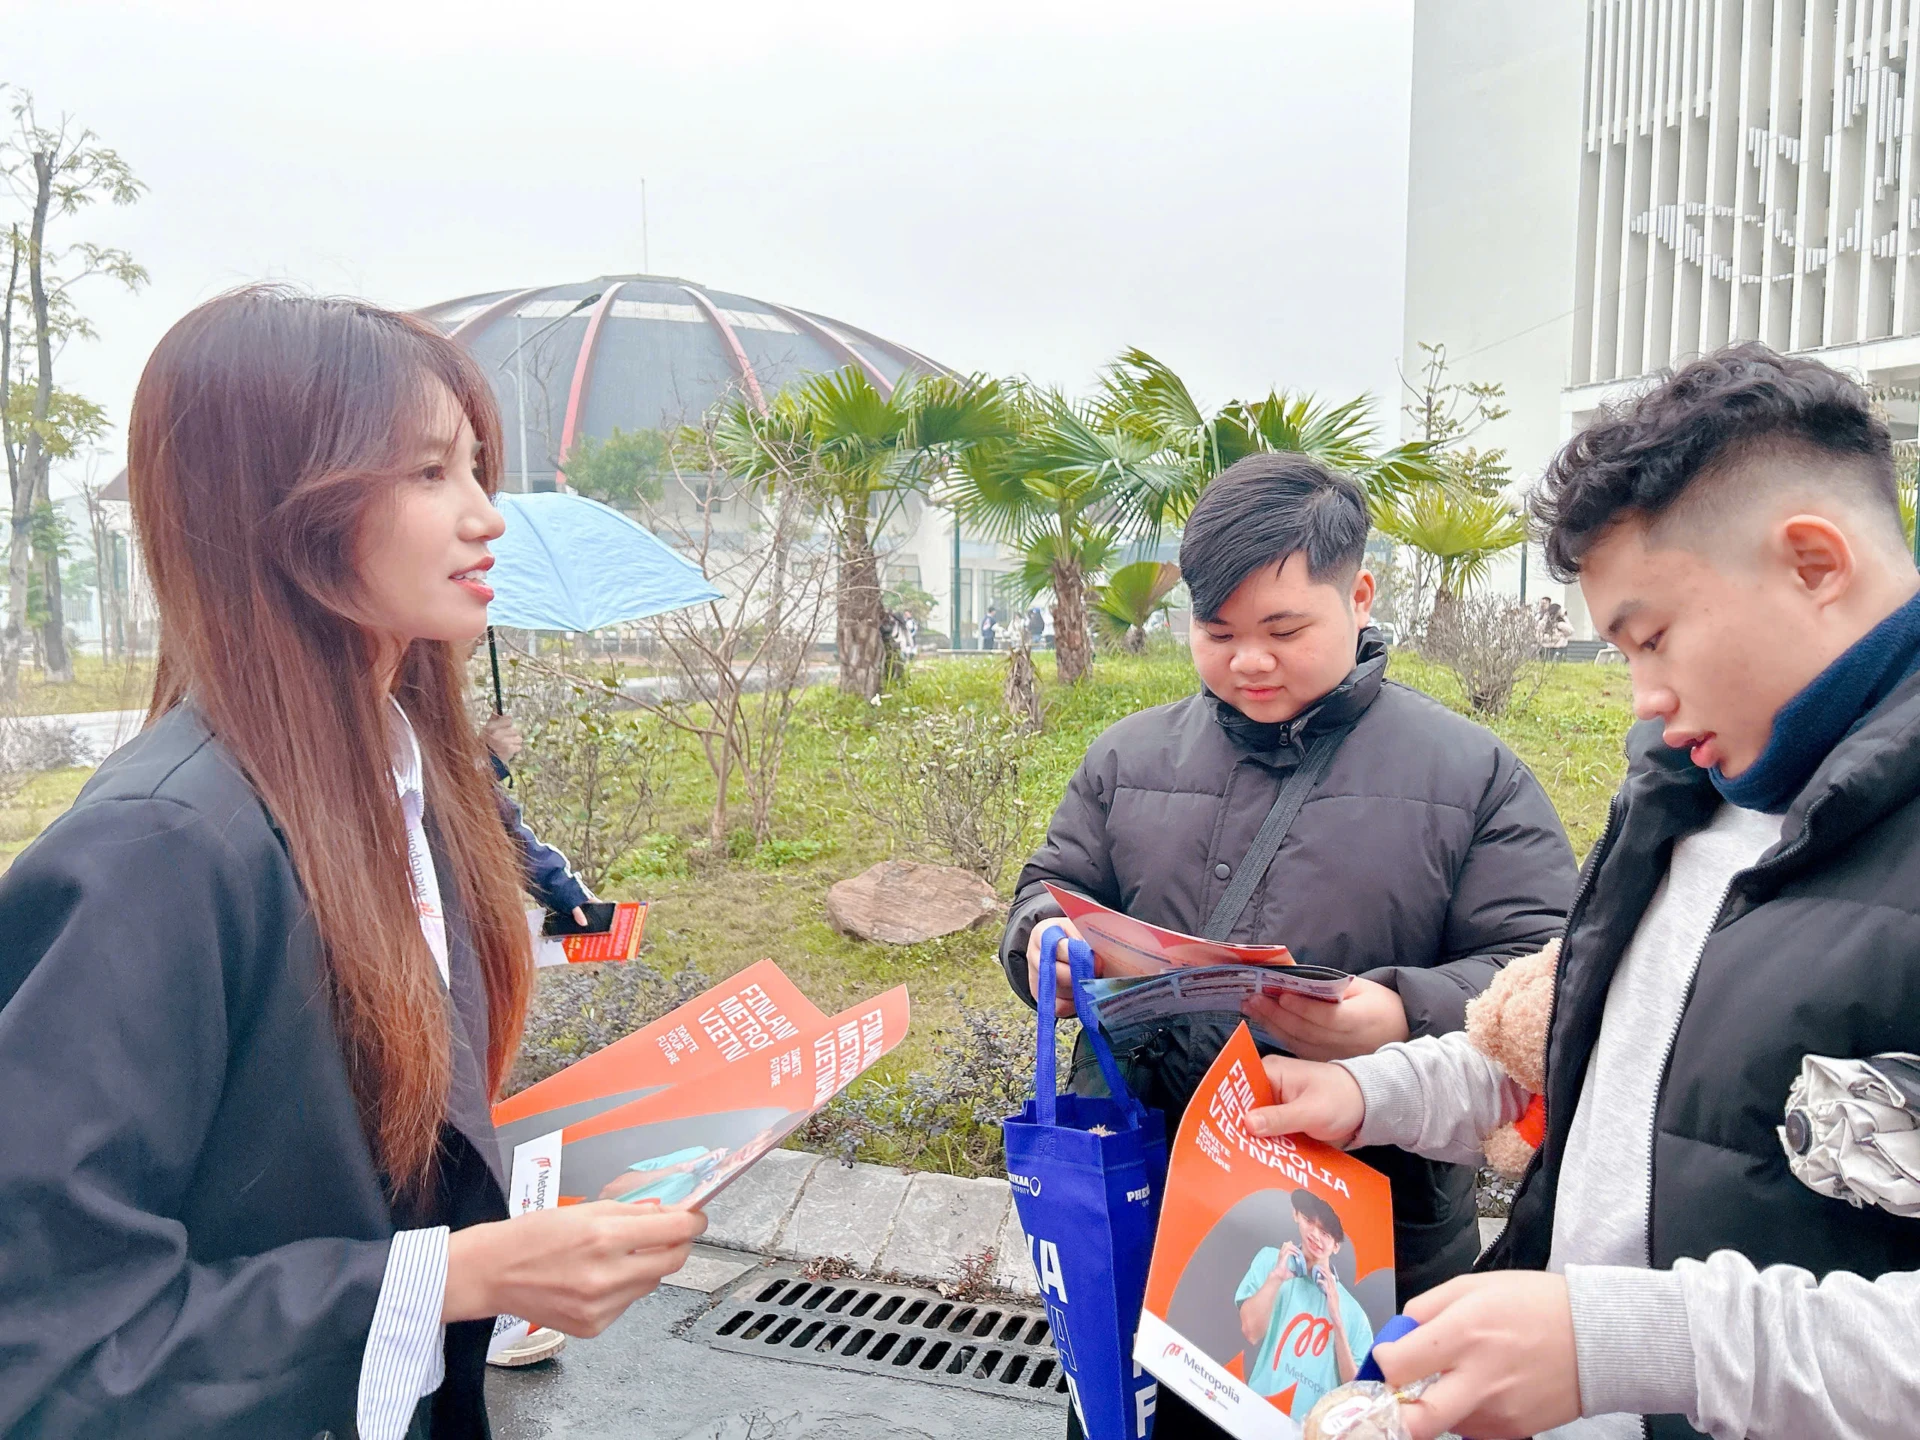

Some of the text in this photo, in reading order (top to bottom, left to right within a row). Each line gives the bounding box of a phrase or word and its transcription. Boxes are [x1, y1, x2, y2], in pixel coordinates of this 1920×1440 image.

[655, 1035, 681, 1066] FUTURE
[666, 1029, 685, 1052] YOUR
[674, 1023, 700, 1054] IGNITE
[698, 1006, 749, 1063] VIETN
[769, 1056, 781, 1088] FUTURE
[780, 1051, 791, 1076] YOUR
[790, 1046, 802, 1078] IGNITE
[1195, 1136, 1231, 1173] FUTURE
[1198, 1128, 1220, 1157] YOUR
[1199, 1119, 1231, 1158] IGNITE
[1209, 1093, 1309, 1188] VIETNAM
[1183, 1352, 1241, 1404] Metropolia
